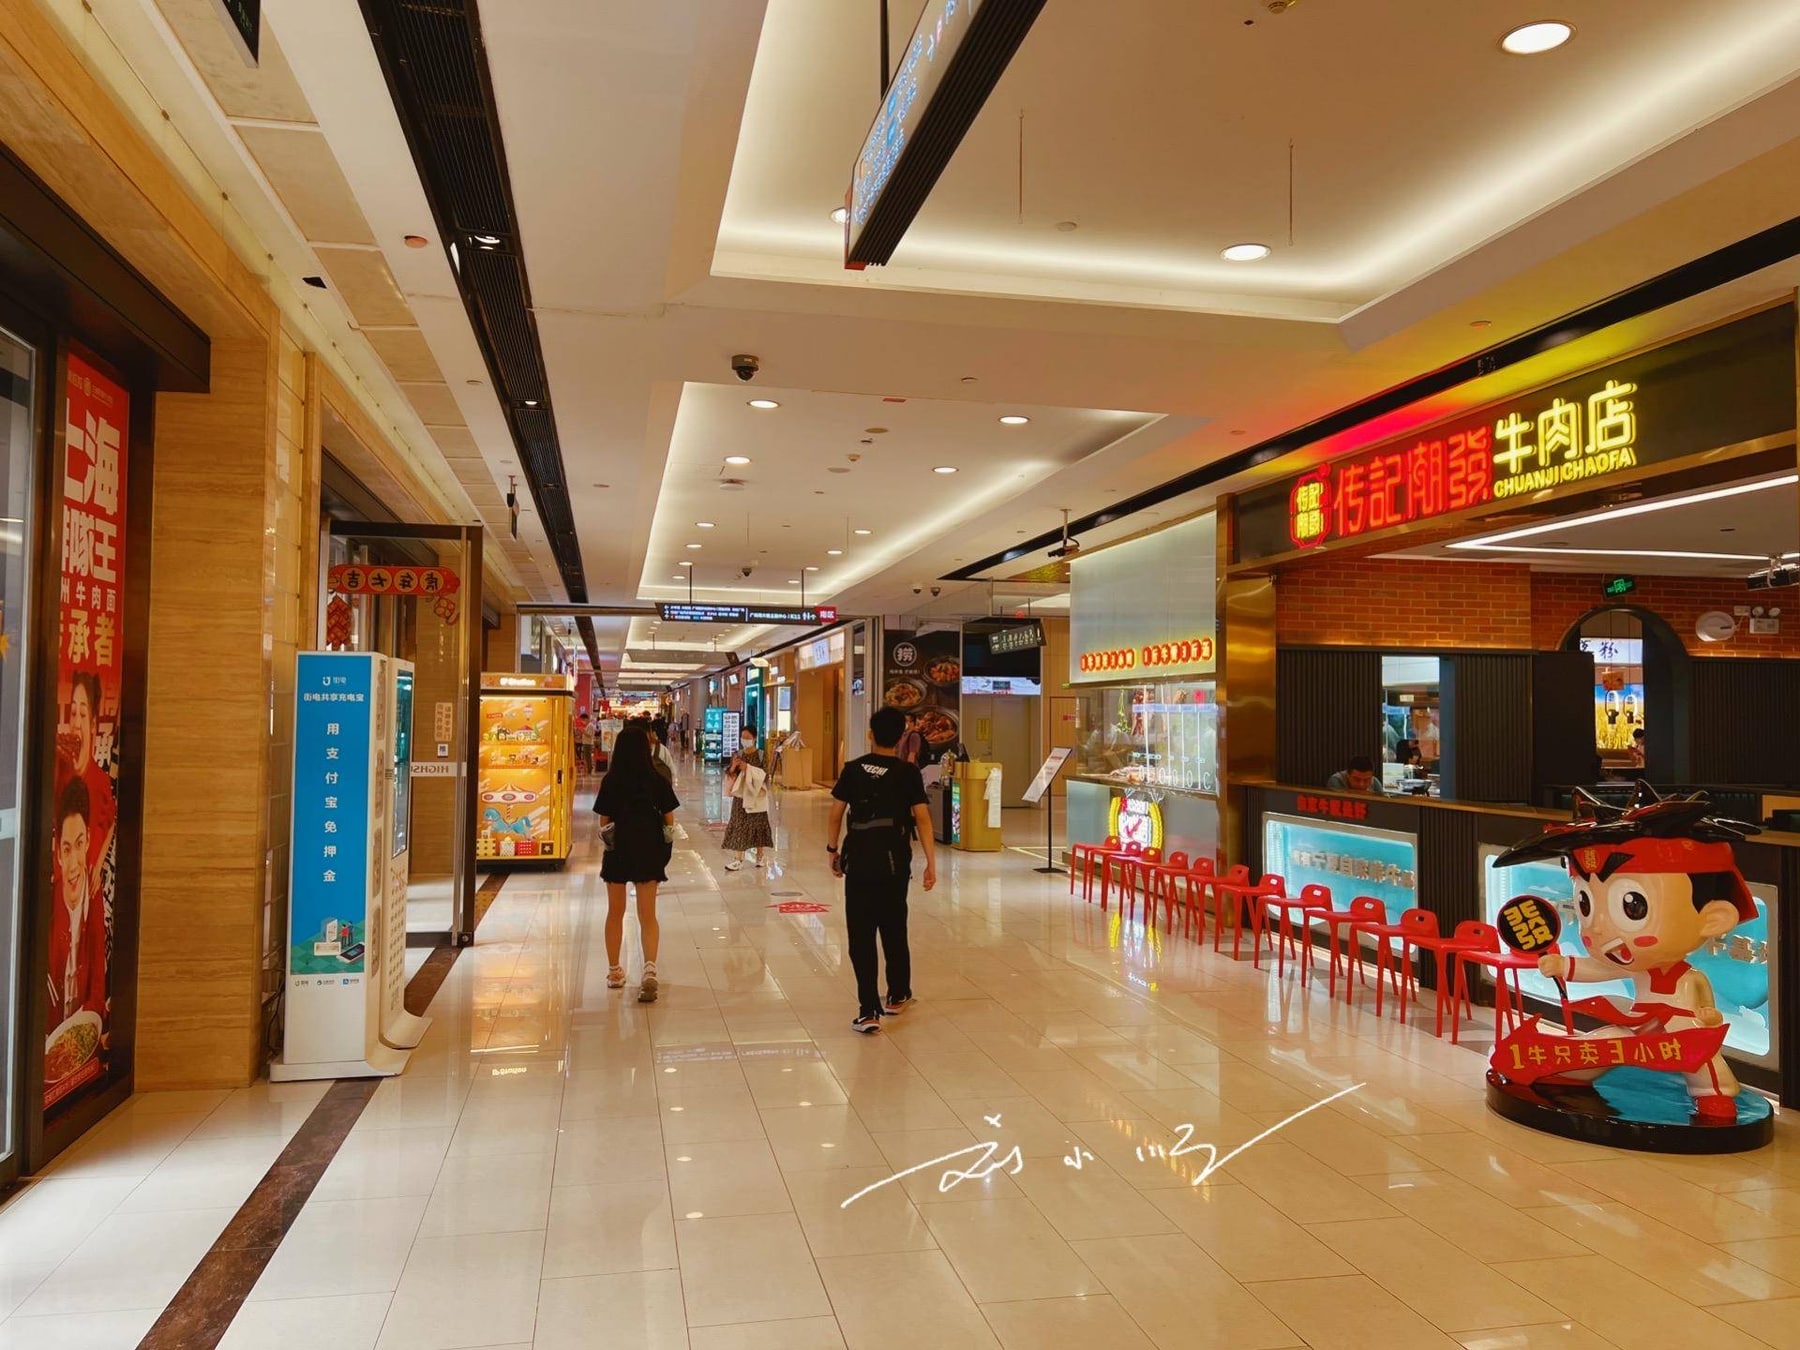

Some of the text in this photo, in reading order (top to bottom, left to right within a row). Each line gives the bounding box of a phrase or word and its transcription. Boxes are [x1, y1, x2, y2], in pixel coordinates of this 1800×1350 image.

[1494, 466, 1561, 498] CHUANJI
[59, 609, 115, 667] 承者
[304, 692, 364, 702] 街电共享充电宝
[322, 722, 340, 882] 用支付宝免押金
[1510, 1038, 1682, 1070] 1牛只卖3小时
